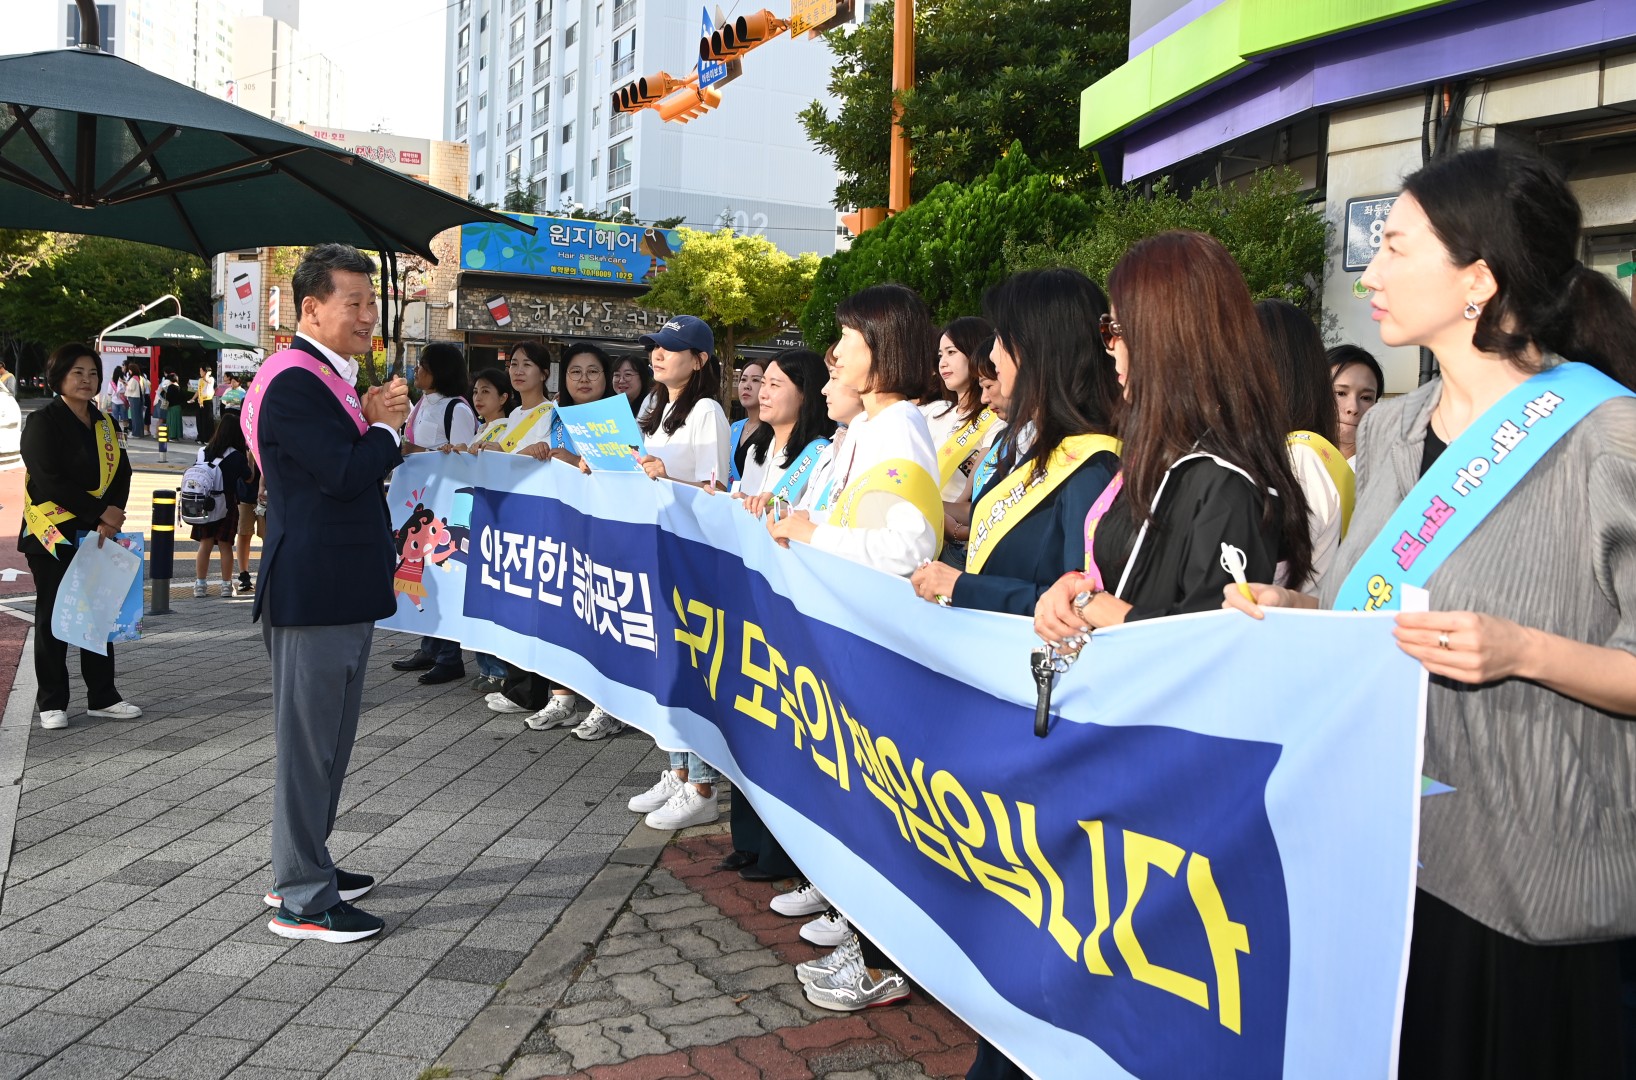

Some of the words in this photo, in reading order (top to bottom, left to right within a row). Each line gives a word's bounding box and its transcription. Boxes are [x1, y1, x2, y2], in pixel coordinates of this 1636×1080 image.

[701, 69, 723, 83] 어린이보호
[549, 224, 637, 253] 원지헤어
[558, 251, 576, 260] Hair
[229, 311, 251, 322] 하삼동
[529, 300, 615, 332] 하삼동
[586, 418, 620, 438] 멋지고
[1451, 389, 1566, 498] 폭력은
[1391, 494, 1458, 573] 절대
[479, 523, 569, 608] 안전한
[840, 699, 1251, 1036] 책임입니다
